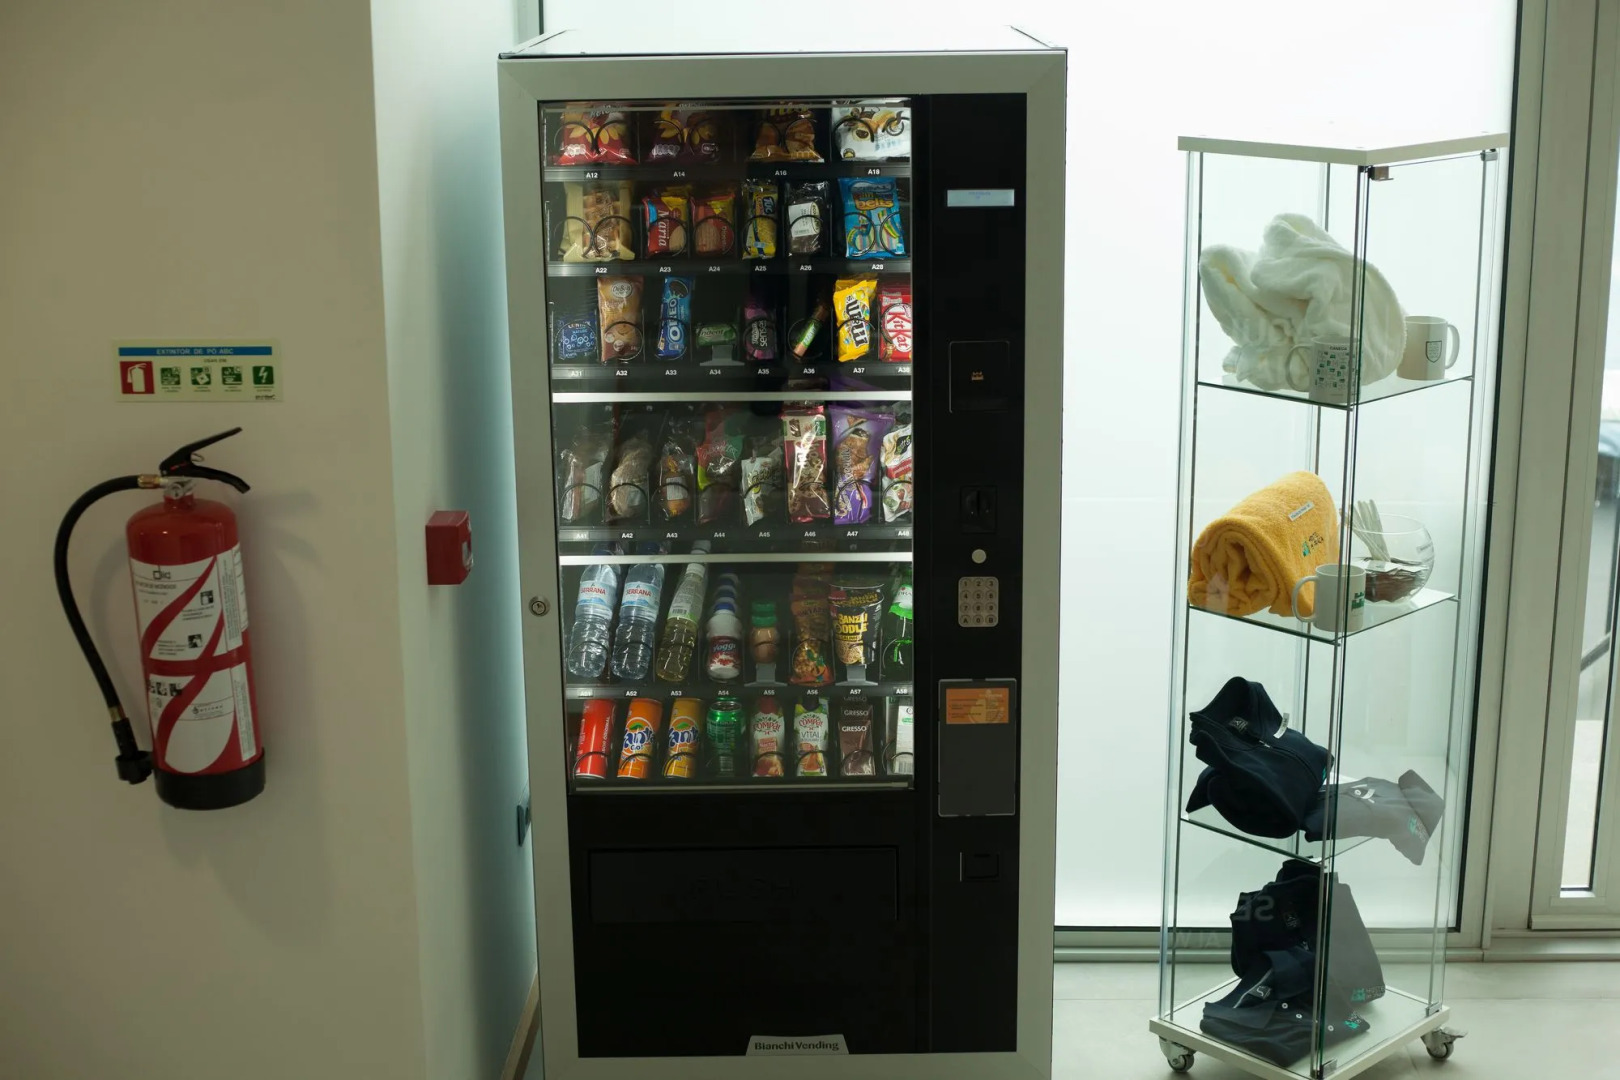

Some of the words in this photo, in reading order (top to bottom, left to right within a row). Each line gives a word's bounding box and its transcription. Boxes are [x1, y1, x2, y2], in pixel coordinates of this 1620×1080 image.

[764, 198, 774, 214] TUC
[667, 299, 680, 341] OREO
[754, 1042, 794, 1050] Bianchi
[795, 1041, 839, 1051] Vending
